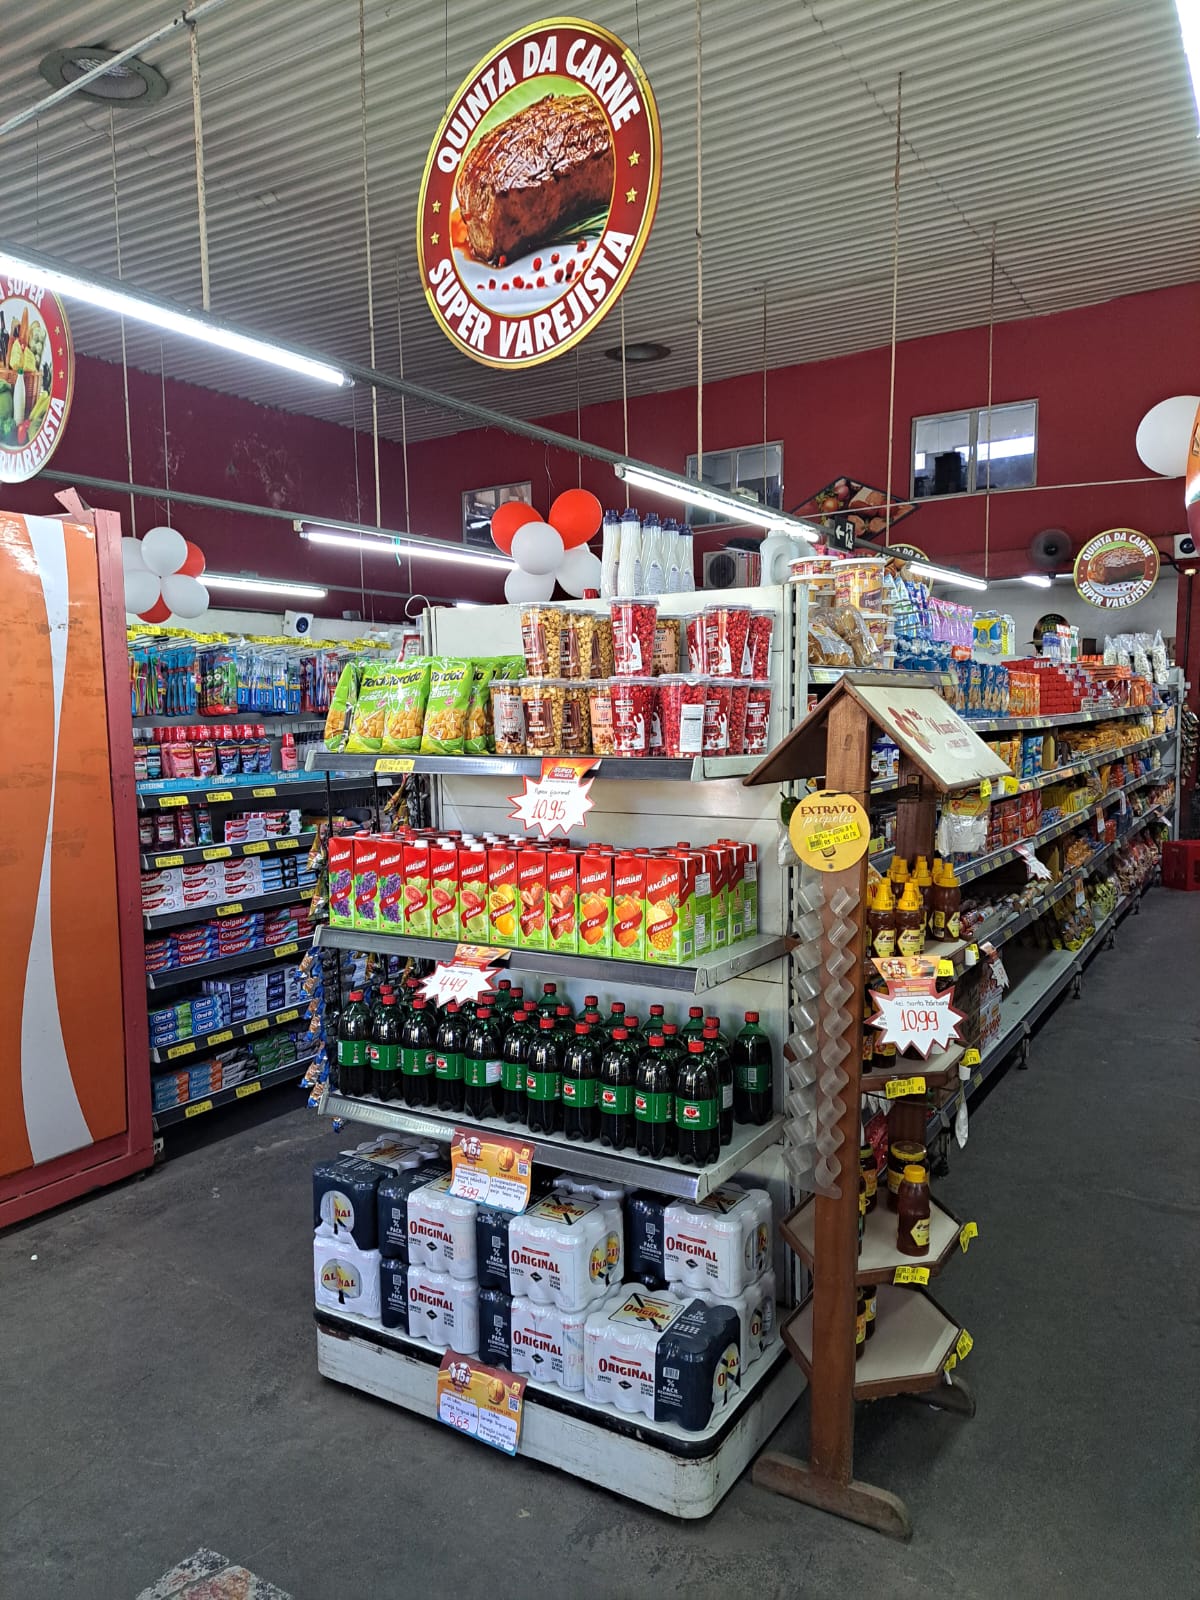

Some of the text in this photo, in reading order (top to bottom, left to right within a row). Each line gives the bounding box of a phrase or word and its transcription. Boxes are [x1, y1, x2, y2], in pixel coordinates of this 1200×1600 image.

[437, 36, 640, 173] QUINTA DA CARNE
[7, 277, 46, 308] SUPER
[429, 230, 635, 358] SUPER VAREJISTA
[8, 397, 65, 474] VAREJISTA
[1082, 532, 1154, 561] QUINTA DA CARNE
[1079, 580, 1153, 607] SUPER VAREJISTA
[801, 805, 857, 814] EXTRATO
[331, 851, 350, 863] MAGUARY
[356, 852, 377, 864] MAGUARY
[380, 853, 400, 867] MAGUARY
[405, 860, 427, 872] MAGUARY
[432, 861, 455, 875] MAGUARY
[461, 864, 484, 877] MAGUARY
[489, 861, 515, 881] MAGUARY
[520, 865, 544, 880] MAGUARY
[550, 867, 574, 881] MAGUARY
[581, 871, 608, 885] MAGUARY
[616, 874, 642, 887] MAGUARY
[647, 871, 679, 893] MAGUARY
[221, 917, 246, 928] Colgate
[221, 928, 246, 939] Colgate
[265, 932, 287, 943] Colgate
[179, 942, 203, 952] Colgate
[221, 940, 247, 952] Colgate
[180, 953, 203, 963] Colgate
[900, 1009, 939, 1032] 10,99
[410, 1221, 454, 1245] ORIGINAL
[666, 1236, 718, 1262] ORIGINAL
[511, 1250, 560, 1274] ORIGINAL
[410, 1287, 454, 1312] ORIGINAL
[623, 1304, 671, 1321] ORIGINAL
[513, 1330, 563, 1357] ORIGINAL
[598, 1358, 654, 1383] ORIGINAL
